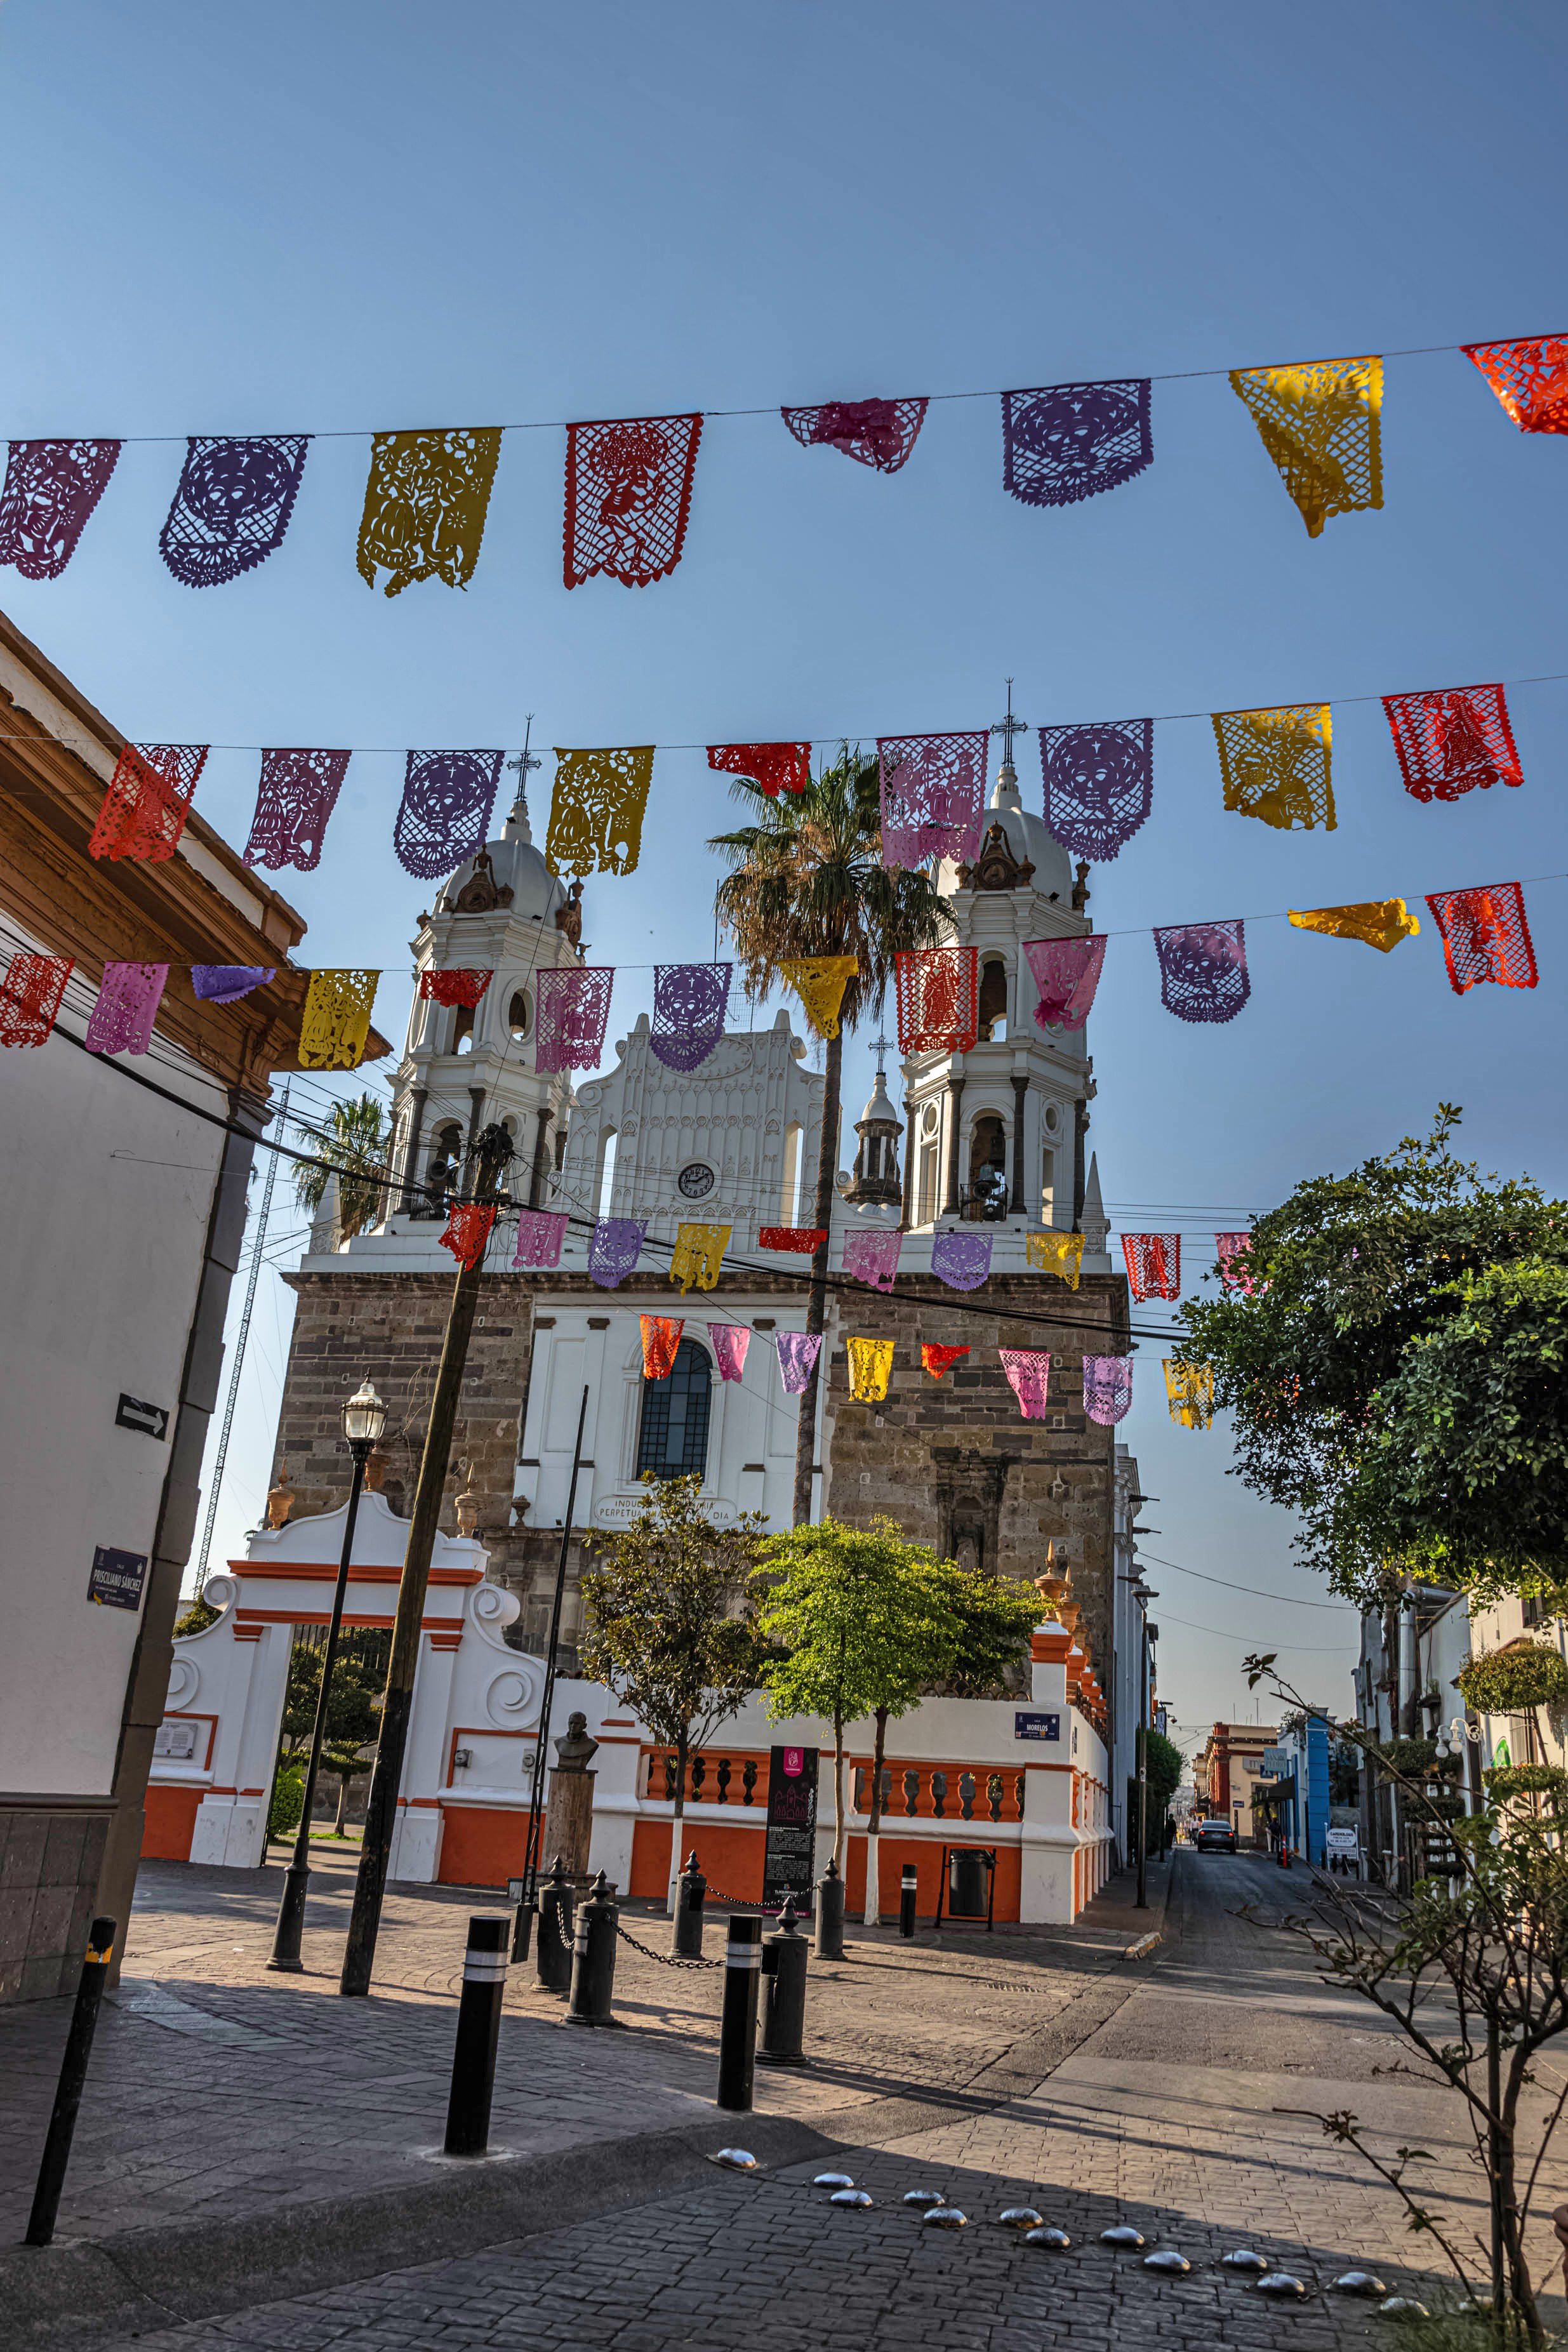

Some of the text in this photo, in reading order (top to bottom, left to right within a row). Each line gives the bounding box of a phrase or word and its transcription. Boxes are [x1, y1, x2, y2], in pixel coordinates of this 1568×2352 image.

[600, 1508, 641, 1517] PERPETUA
[93, 1569, 122, 1587] PRISCILIANO
[121, 1574, 142, 1591] SÁNCHEZ
[1027, 1724, 1048, 1732] MORELOS
